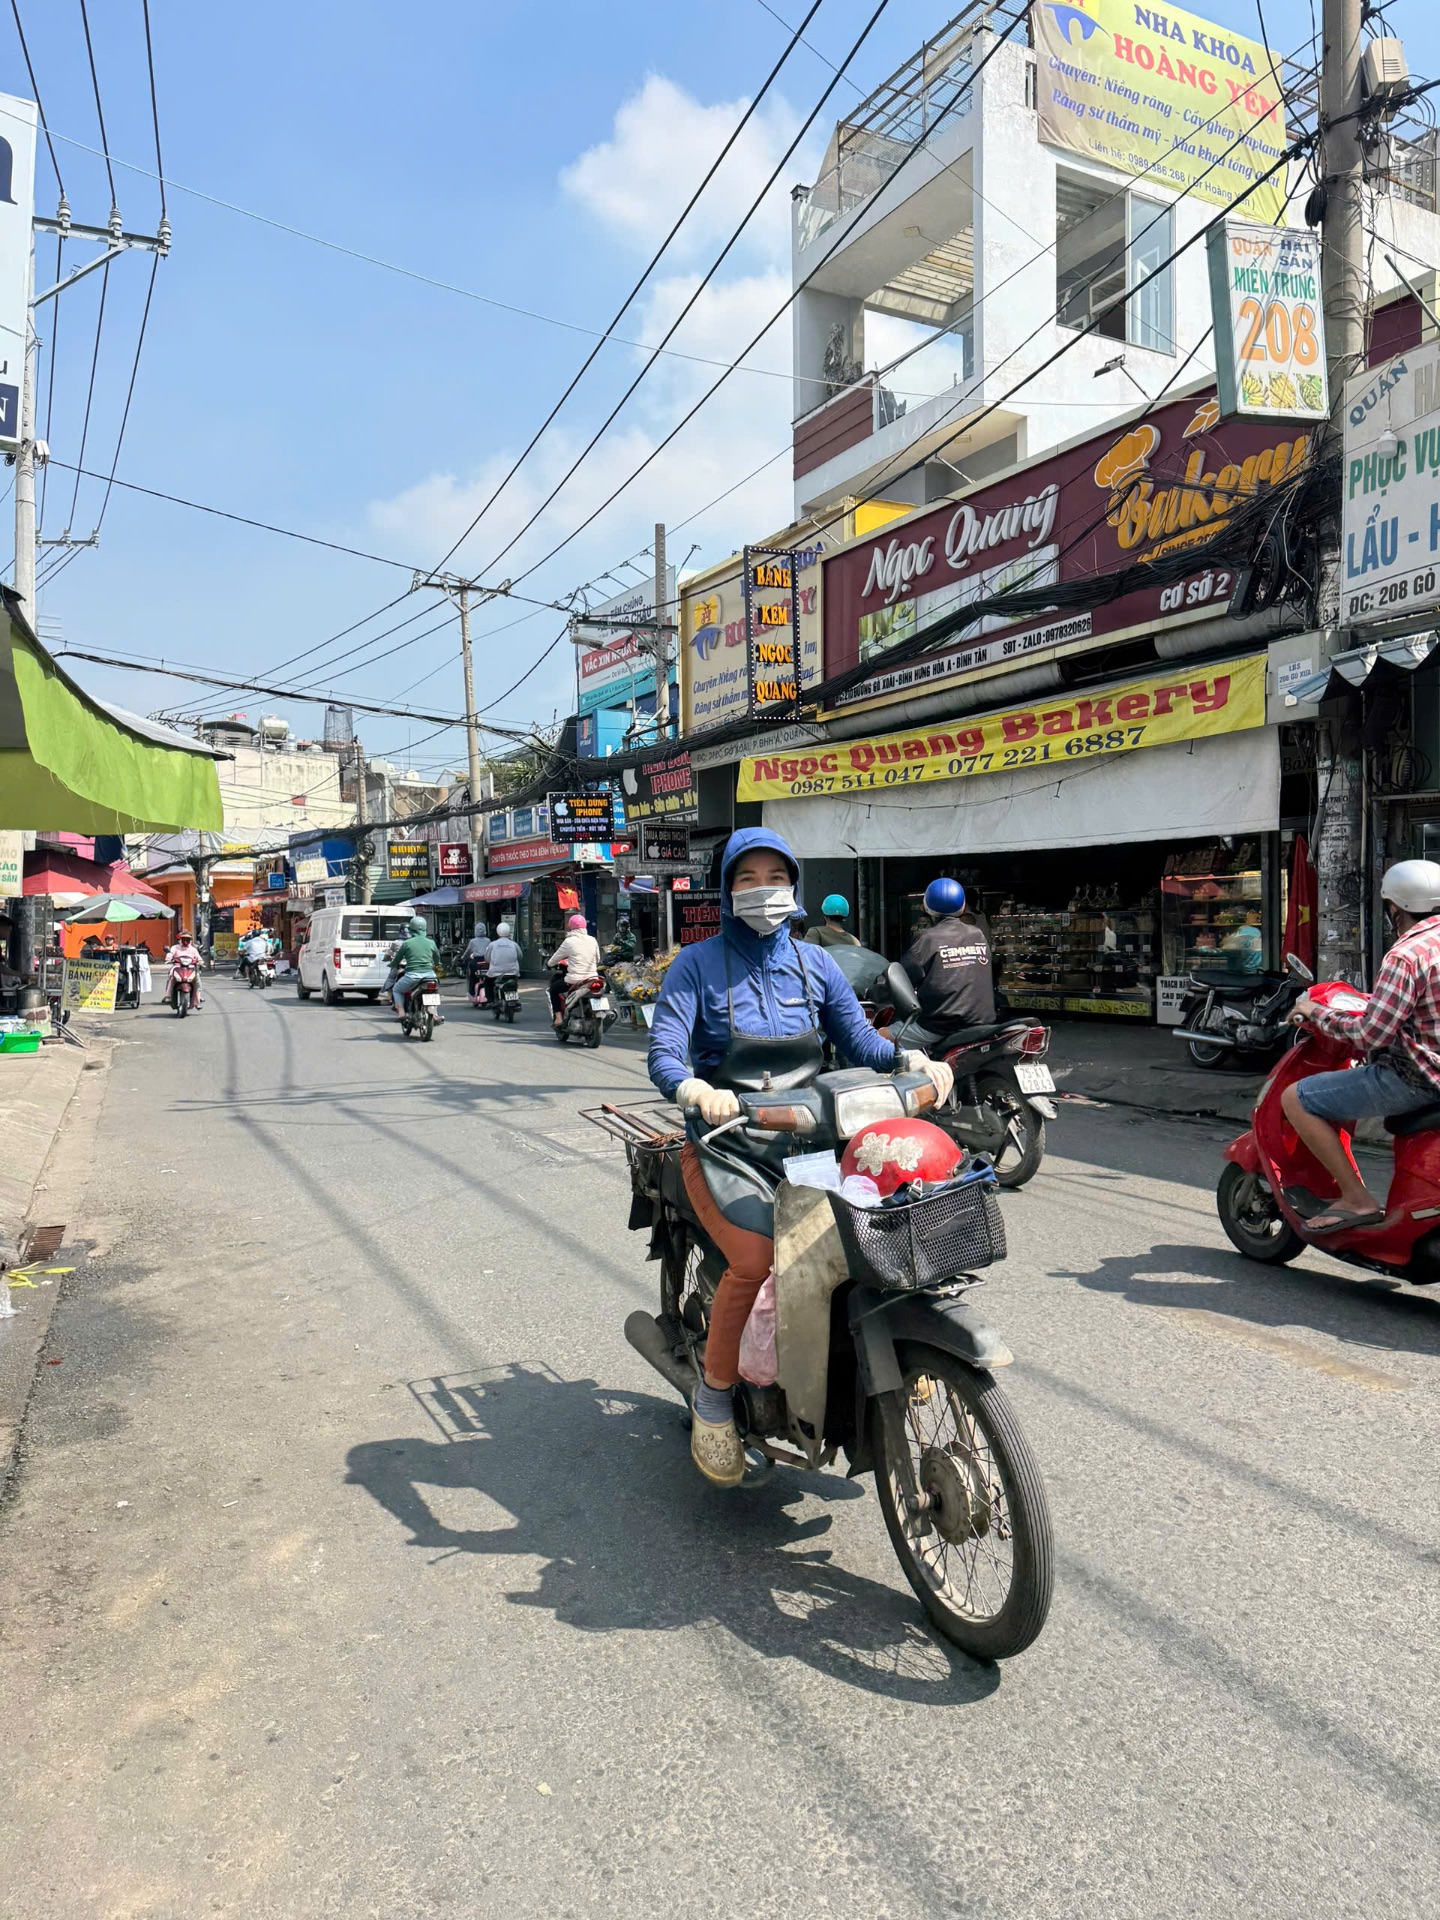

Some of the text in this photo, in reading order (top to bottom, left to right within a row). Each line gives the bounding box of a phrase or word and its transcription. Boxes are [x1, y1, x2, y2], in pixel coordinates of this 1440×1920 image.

[1134, 4, 1186, 44] NHA
[1113, 33, 1217, 95] HOÀNG
[1052, 87, 1086, 118] Răng
[1088, 104, 1105, 121] sứ
[1105, 110, 1140, 135] thẩm
[1104, 77, 1140, 105] Niềng
[1142, 94, 1172, 118] răng
[1206, 121, 1235, 142] ghép
[1271, 271, 1317, 300] TRUNG
[1239, 296, 1319, 366] 208
[1350, 358, 1408, 428] QUÁN
[861, 535, 936, 605] Ngọc
[944, 483, 1061, 570] Quang
[1347, 504, 1398, 579] LẨU
[1159, 581, 1186, 612] CƠ
[1186, 568, 1214, 607] SỞ
[1213, 572, 1231, 597] 2
[1379, 579, 1408, 607] 208
[1413, 566, 1436, 596] GÒ
[761, 605, 788, 625] KEM
[759, 643, 793, 667] NGỌC
[956, 653, 973, 668] BÌNH
[974, 648, 988, 663] TÂN
[756, 681, 797, 703] QUANG
[753, 675, 1231, 783] Ngọc Quang Bakery
[790, 725, 1147, 795] 0987 511 047 077 221 6887
[650, 767, 692, 795] IPHONE
[575, 808, 603, 816] IPHONE
[673, 847, 686, 858] CAO
[68, 968, 92, 982] BÁNH
